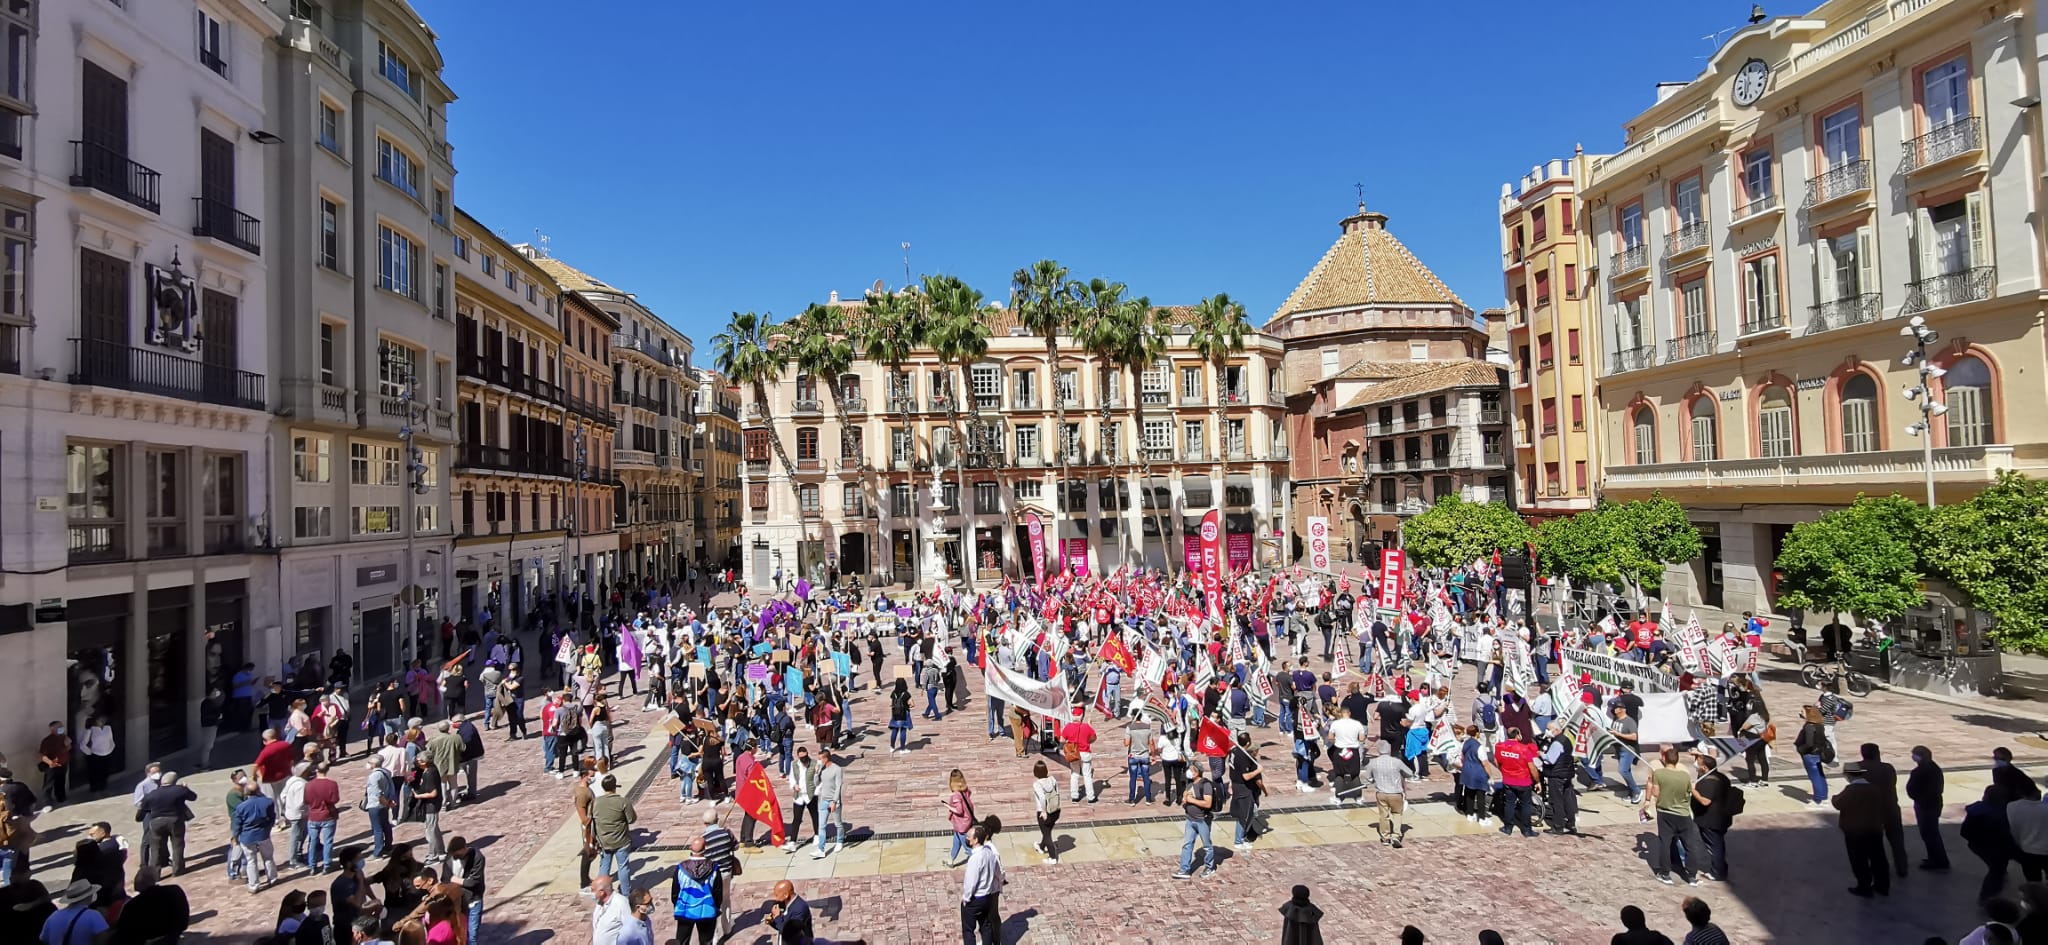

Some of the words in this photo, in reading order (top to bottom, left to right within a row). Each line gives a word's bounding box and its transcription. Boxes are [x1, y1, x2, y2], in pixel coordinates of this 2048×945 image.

[1382, 551, 1399, 609] CCOO
[559, 637, 570, 659] CCOO
[1562, 648, 1611, 670] TRABAJADORES
[1720, 641, 1736, 670] CCOO
